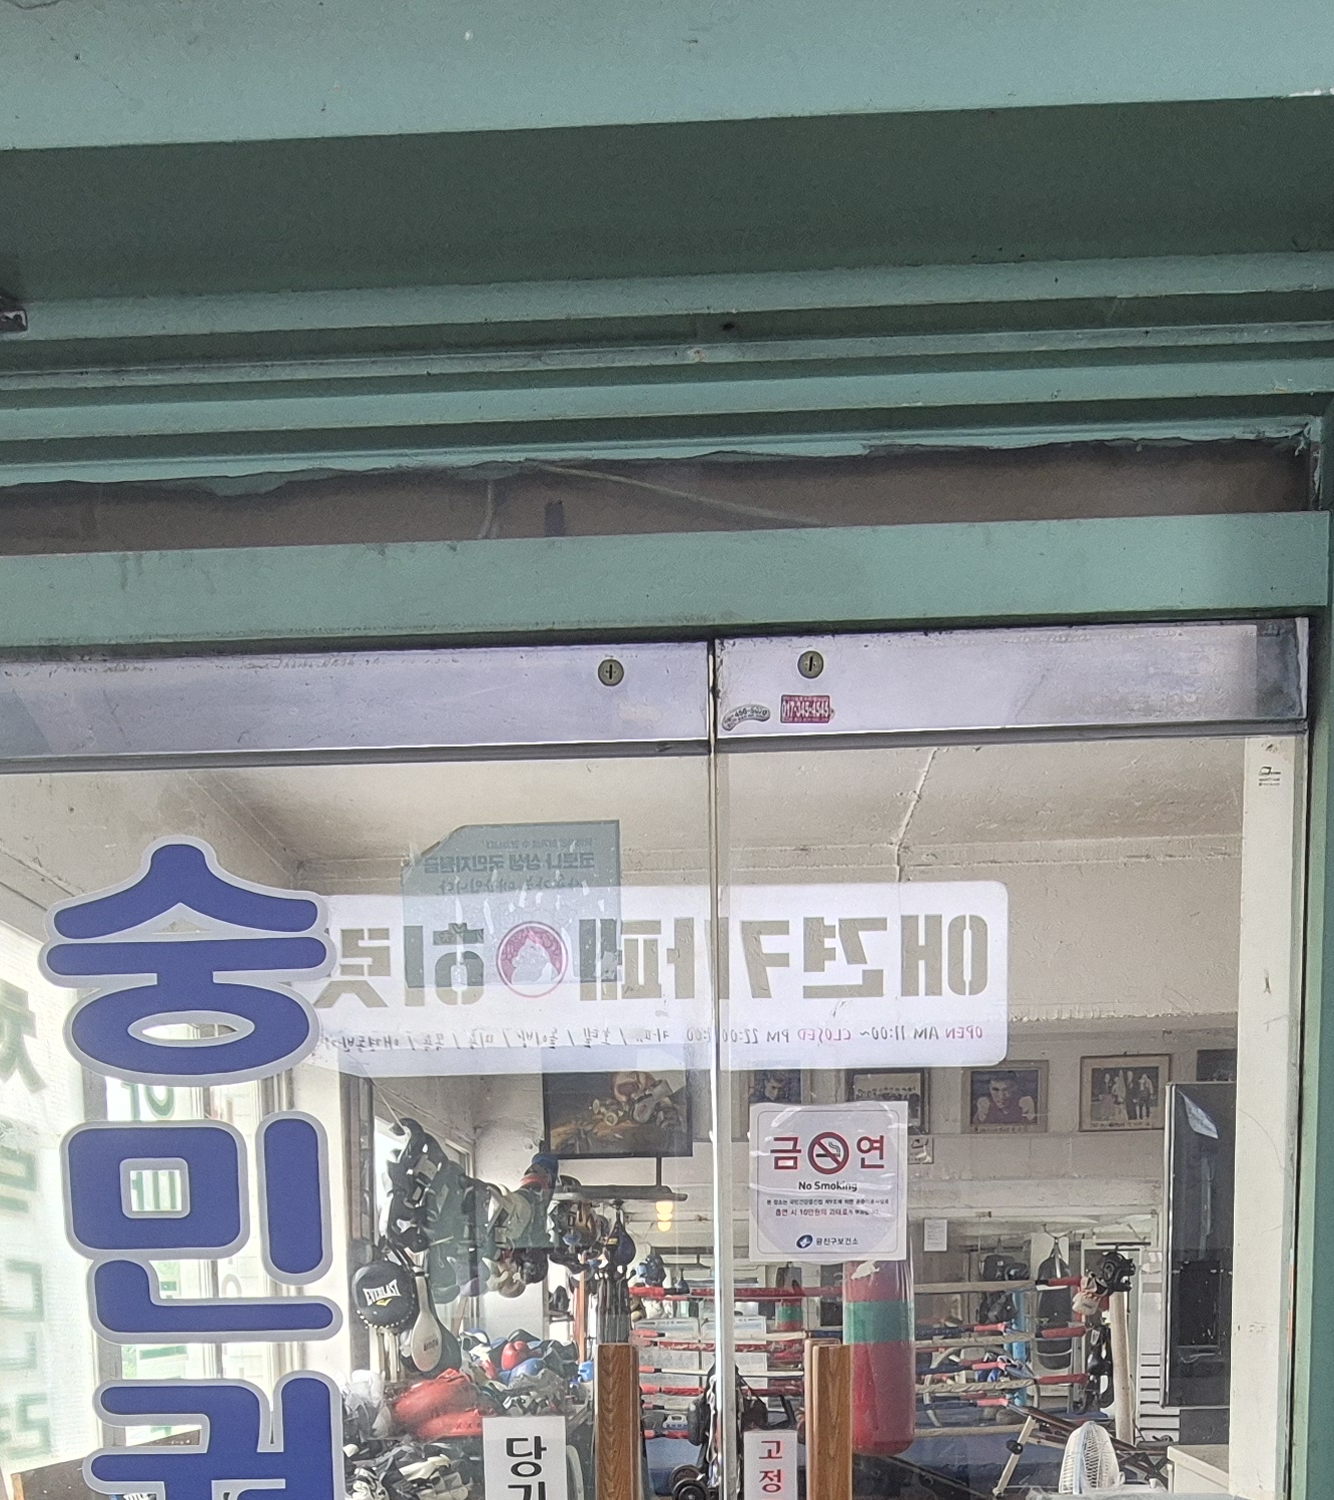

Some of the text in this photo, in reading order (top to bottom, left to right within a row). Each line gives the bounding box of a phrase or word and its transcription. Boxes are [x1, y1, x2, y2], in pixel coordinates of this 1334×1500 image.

[798, 1181, 858, 1192] No Smoking
[362, 1278, 403, 1307] EVERLAST
